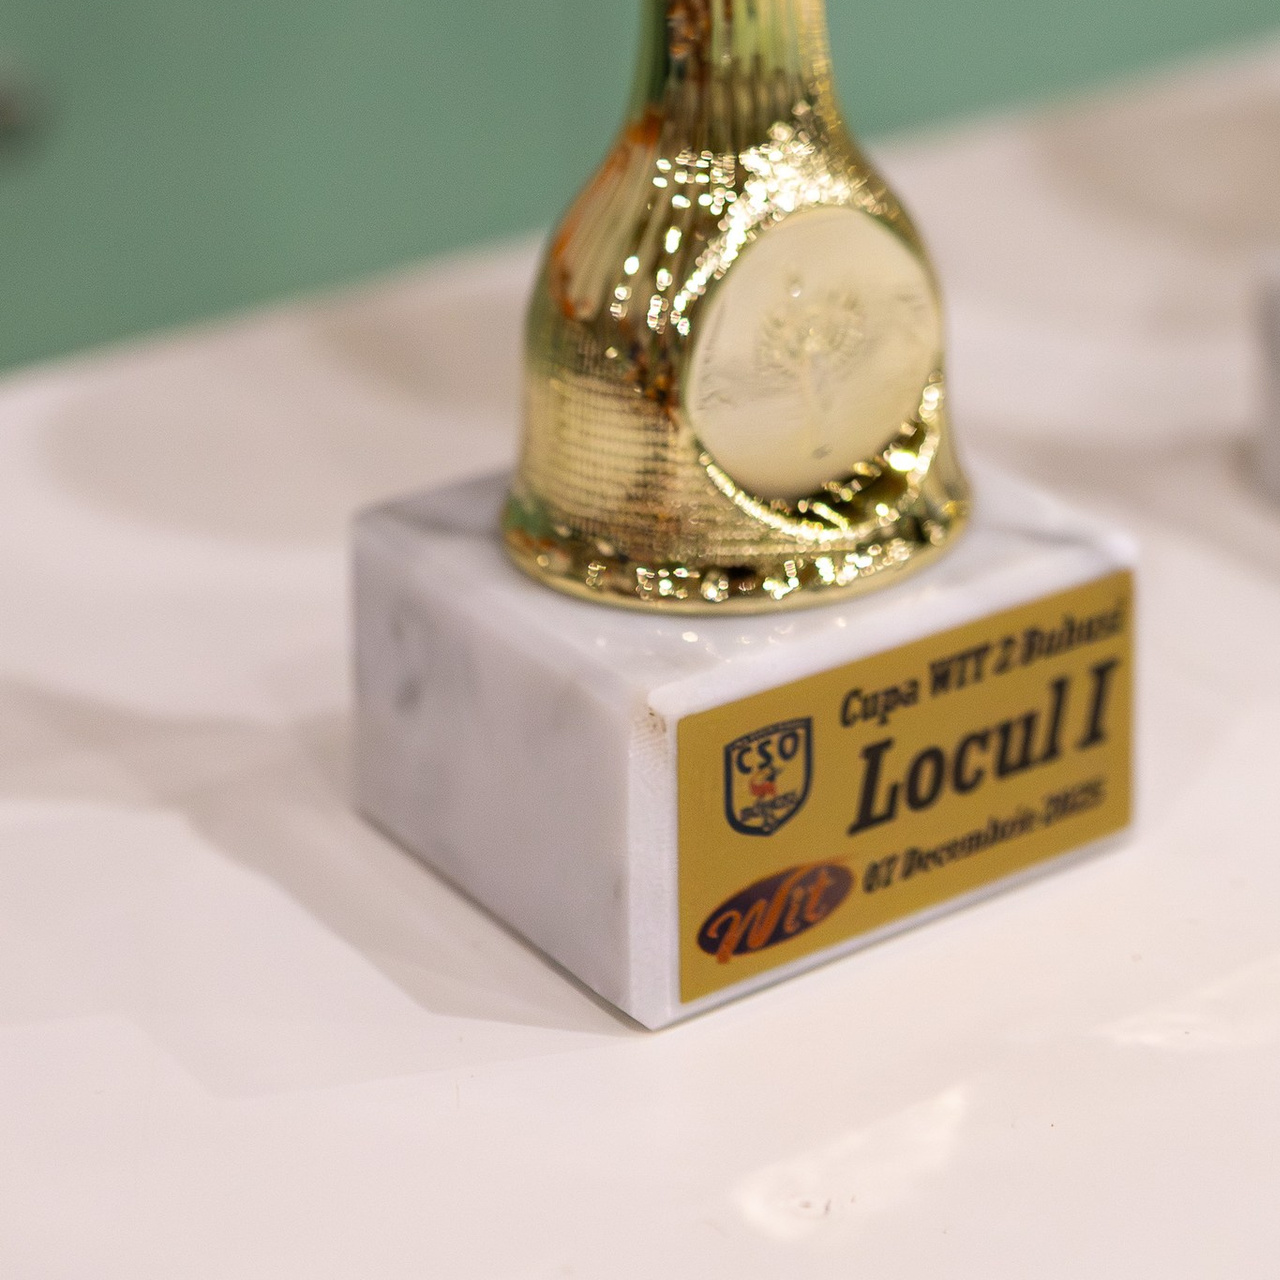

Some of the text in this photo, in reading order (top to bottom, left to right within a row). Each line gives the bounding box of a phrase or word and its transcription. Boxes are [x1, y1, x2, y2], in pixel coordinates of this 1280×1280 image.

[841, 687, 920, 727] Cupa
[929, 643, 991, 697] WIT
[736, 730, 799, 775] CSO
[847, 656, 1119, 836] Locul I
[706, 853, 853, 964] Wit
